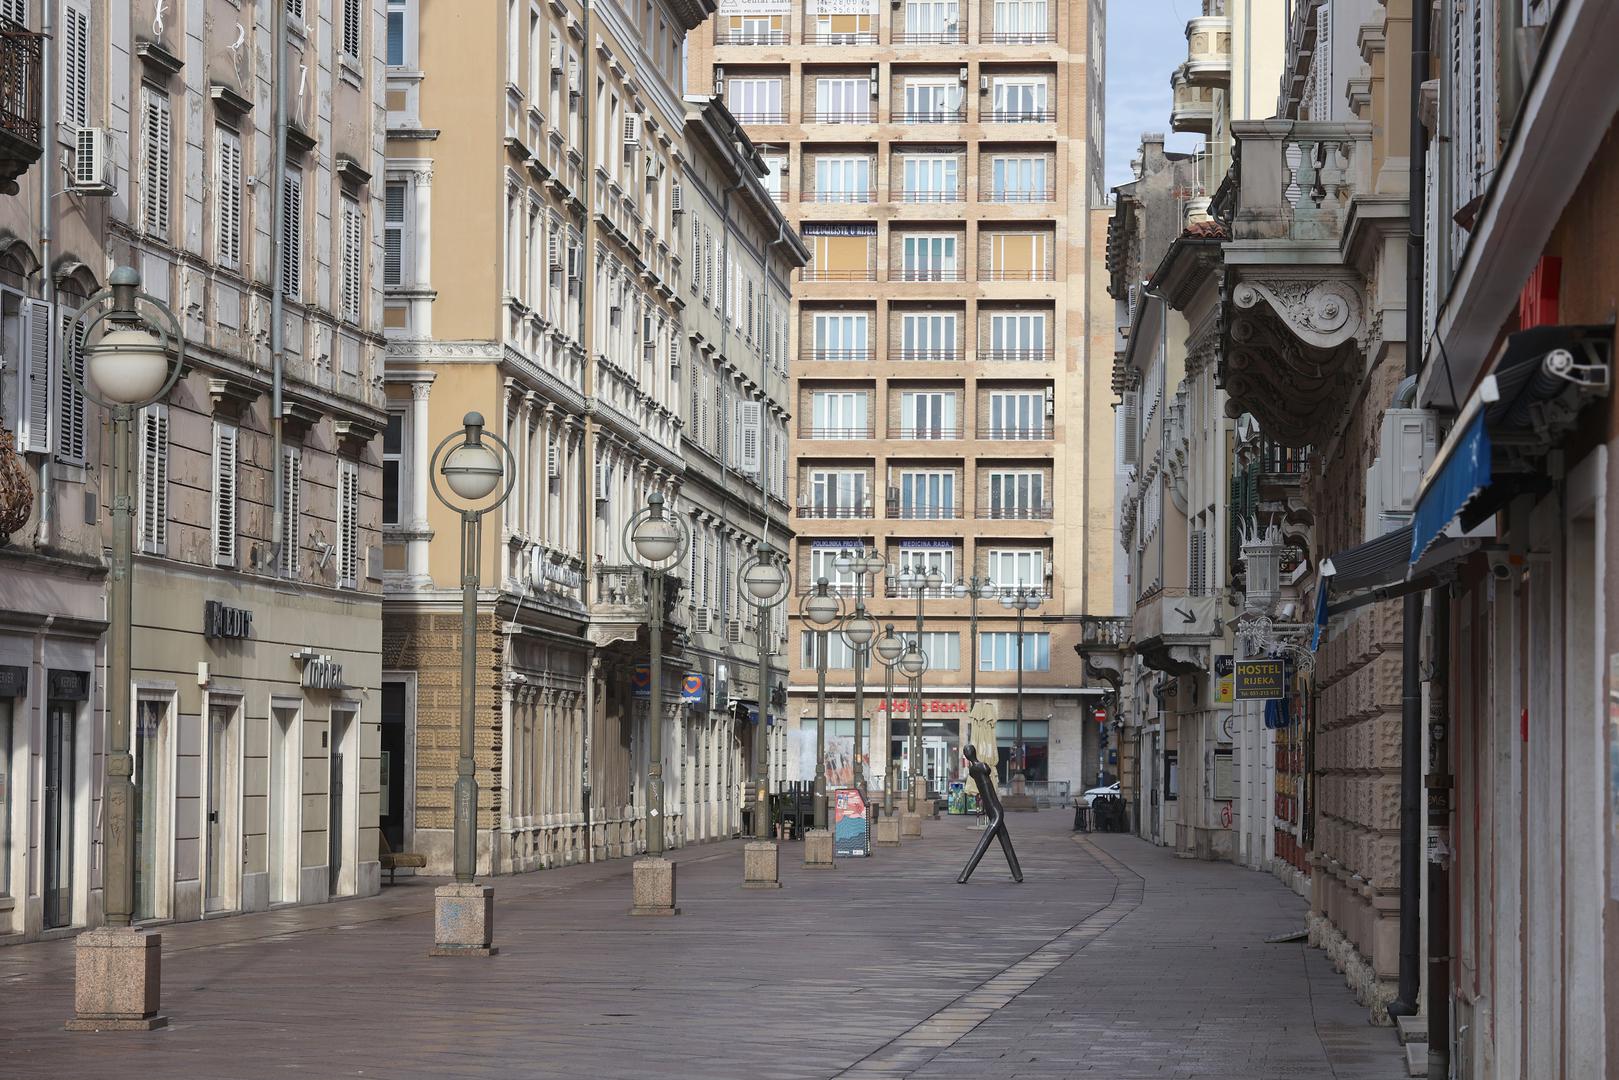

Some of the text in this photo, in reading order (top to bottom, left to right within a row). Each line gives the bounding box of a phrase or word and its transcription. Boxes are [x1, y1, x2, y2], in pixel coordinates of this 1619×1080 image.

[1238, 664, 1281, 675] HOSTEL
[1243, 677, 1275, 685] RIJEKA
[877, 699, 968, 712] Addio Bank
